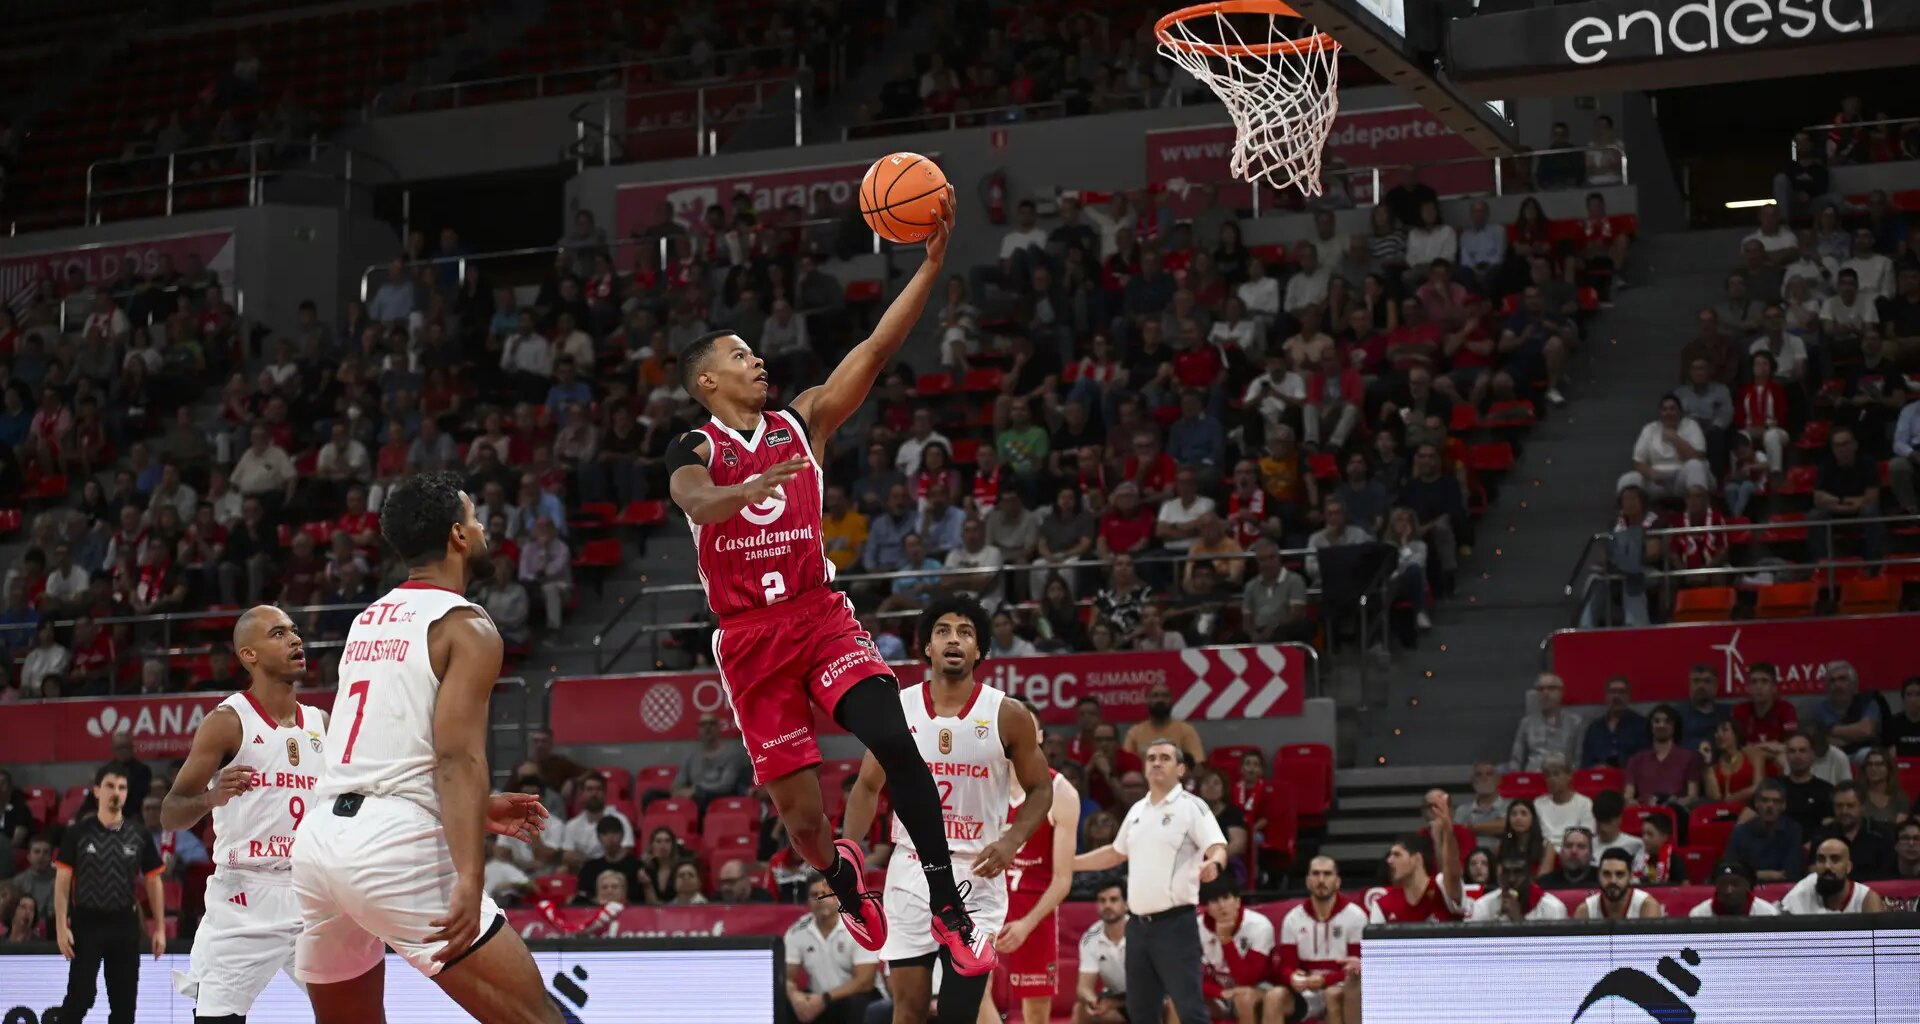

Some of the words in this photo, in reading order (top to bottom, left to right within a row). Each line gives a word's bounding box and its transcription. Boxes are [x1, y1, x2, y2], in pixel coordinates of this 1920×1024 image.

[1564, 0, 1874, 64] endesa
[715, 524, 814, 552] Casademont
[745, 545, 791, 560] ZARAGOZA
[761, 571, 788, 605] 2
[828, 650, 866, 672] Zaragoza
[831, 656, 870, 679] DEPORTE
[1734, 661, 1828, 684] ALAYA
[1086, 669, 1167, 688] SUMAMOS
[341, 680, 370, 764] 7
[762, 726, 808, 750] azulmarino
[250, 772, 272, 788] SL
[927, 762, 989, 779] BENFICA
[289, 796, 305, 831] 9
[943, 821, 984, 840] IREZ
